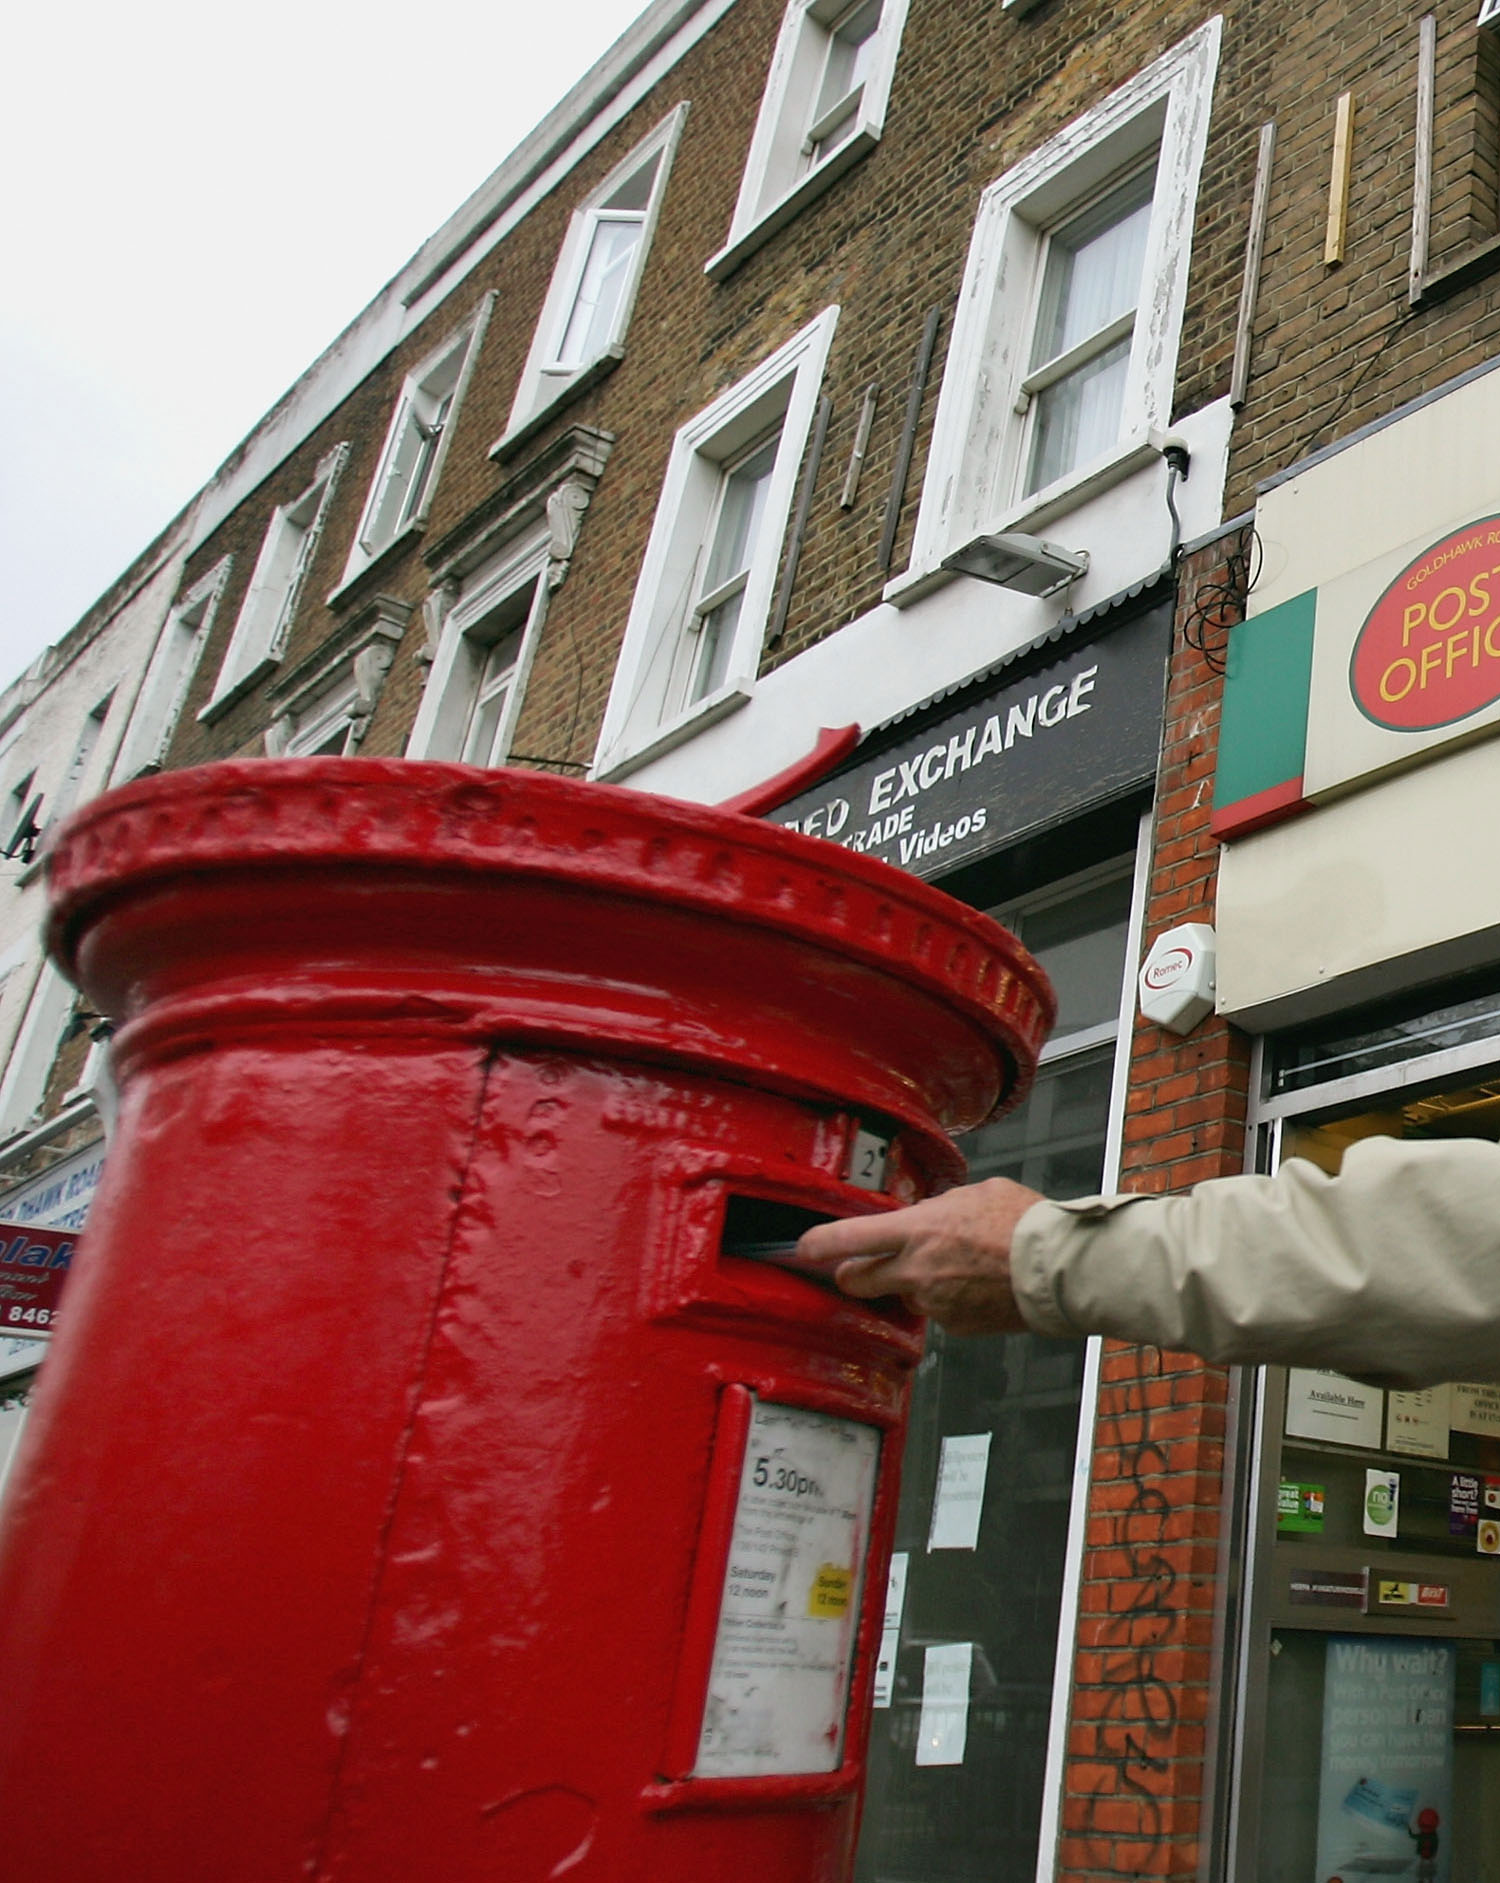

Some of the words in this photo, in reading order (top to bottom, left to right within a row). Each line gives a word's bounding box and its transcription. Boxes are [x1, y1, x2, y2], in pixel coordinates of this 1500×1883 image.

[1406, 535, 1483, 590] GOLDHAWK
[868, 665, 1099, 815] EXCHANGE
[899, 808, 987, 864] Videos
[860, 1149, 875, 1178] 2
[1310, 1389, 1346, 1404] Available
[1452, 1475, 1459, 1486] A
[730, 1564, 776, 1584] Saturday
[1335, 1644, 1387, 1682] Why
[1392, 1647, 1449, 1678] wait?
[1331, 1706, 1408, 1730] personal
